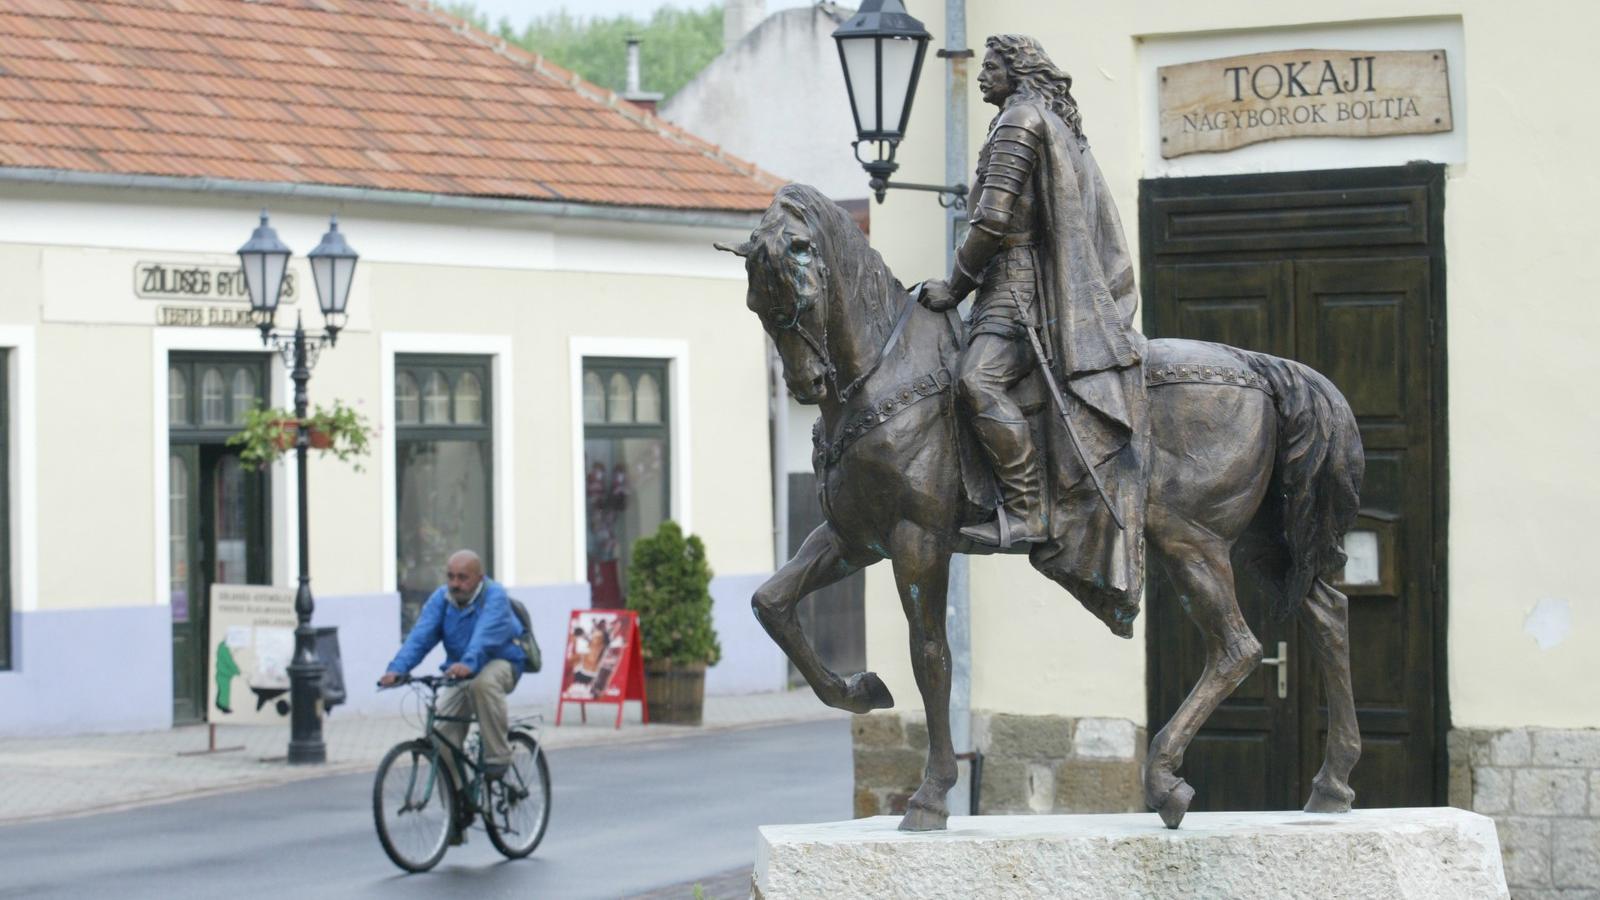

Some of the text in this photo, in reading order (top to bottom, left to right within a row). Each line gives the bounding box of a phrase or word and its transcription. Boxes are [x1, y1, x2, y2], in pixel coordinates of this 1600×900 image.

[1224, 57, 1376, 102] TOKAJI
[1182, 98, 1420, 133] NAGYBOROK BOLTJA
[142, 266, 211, 295] ZÖLDSÉG
